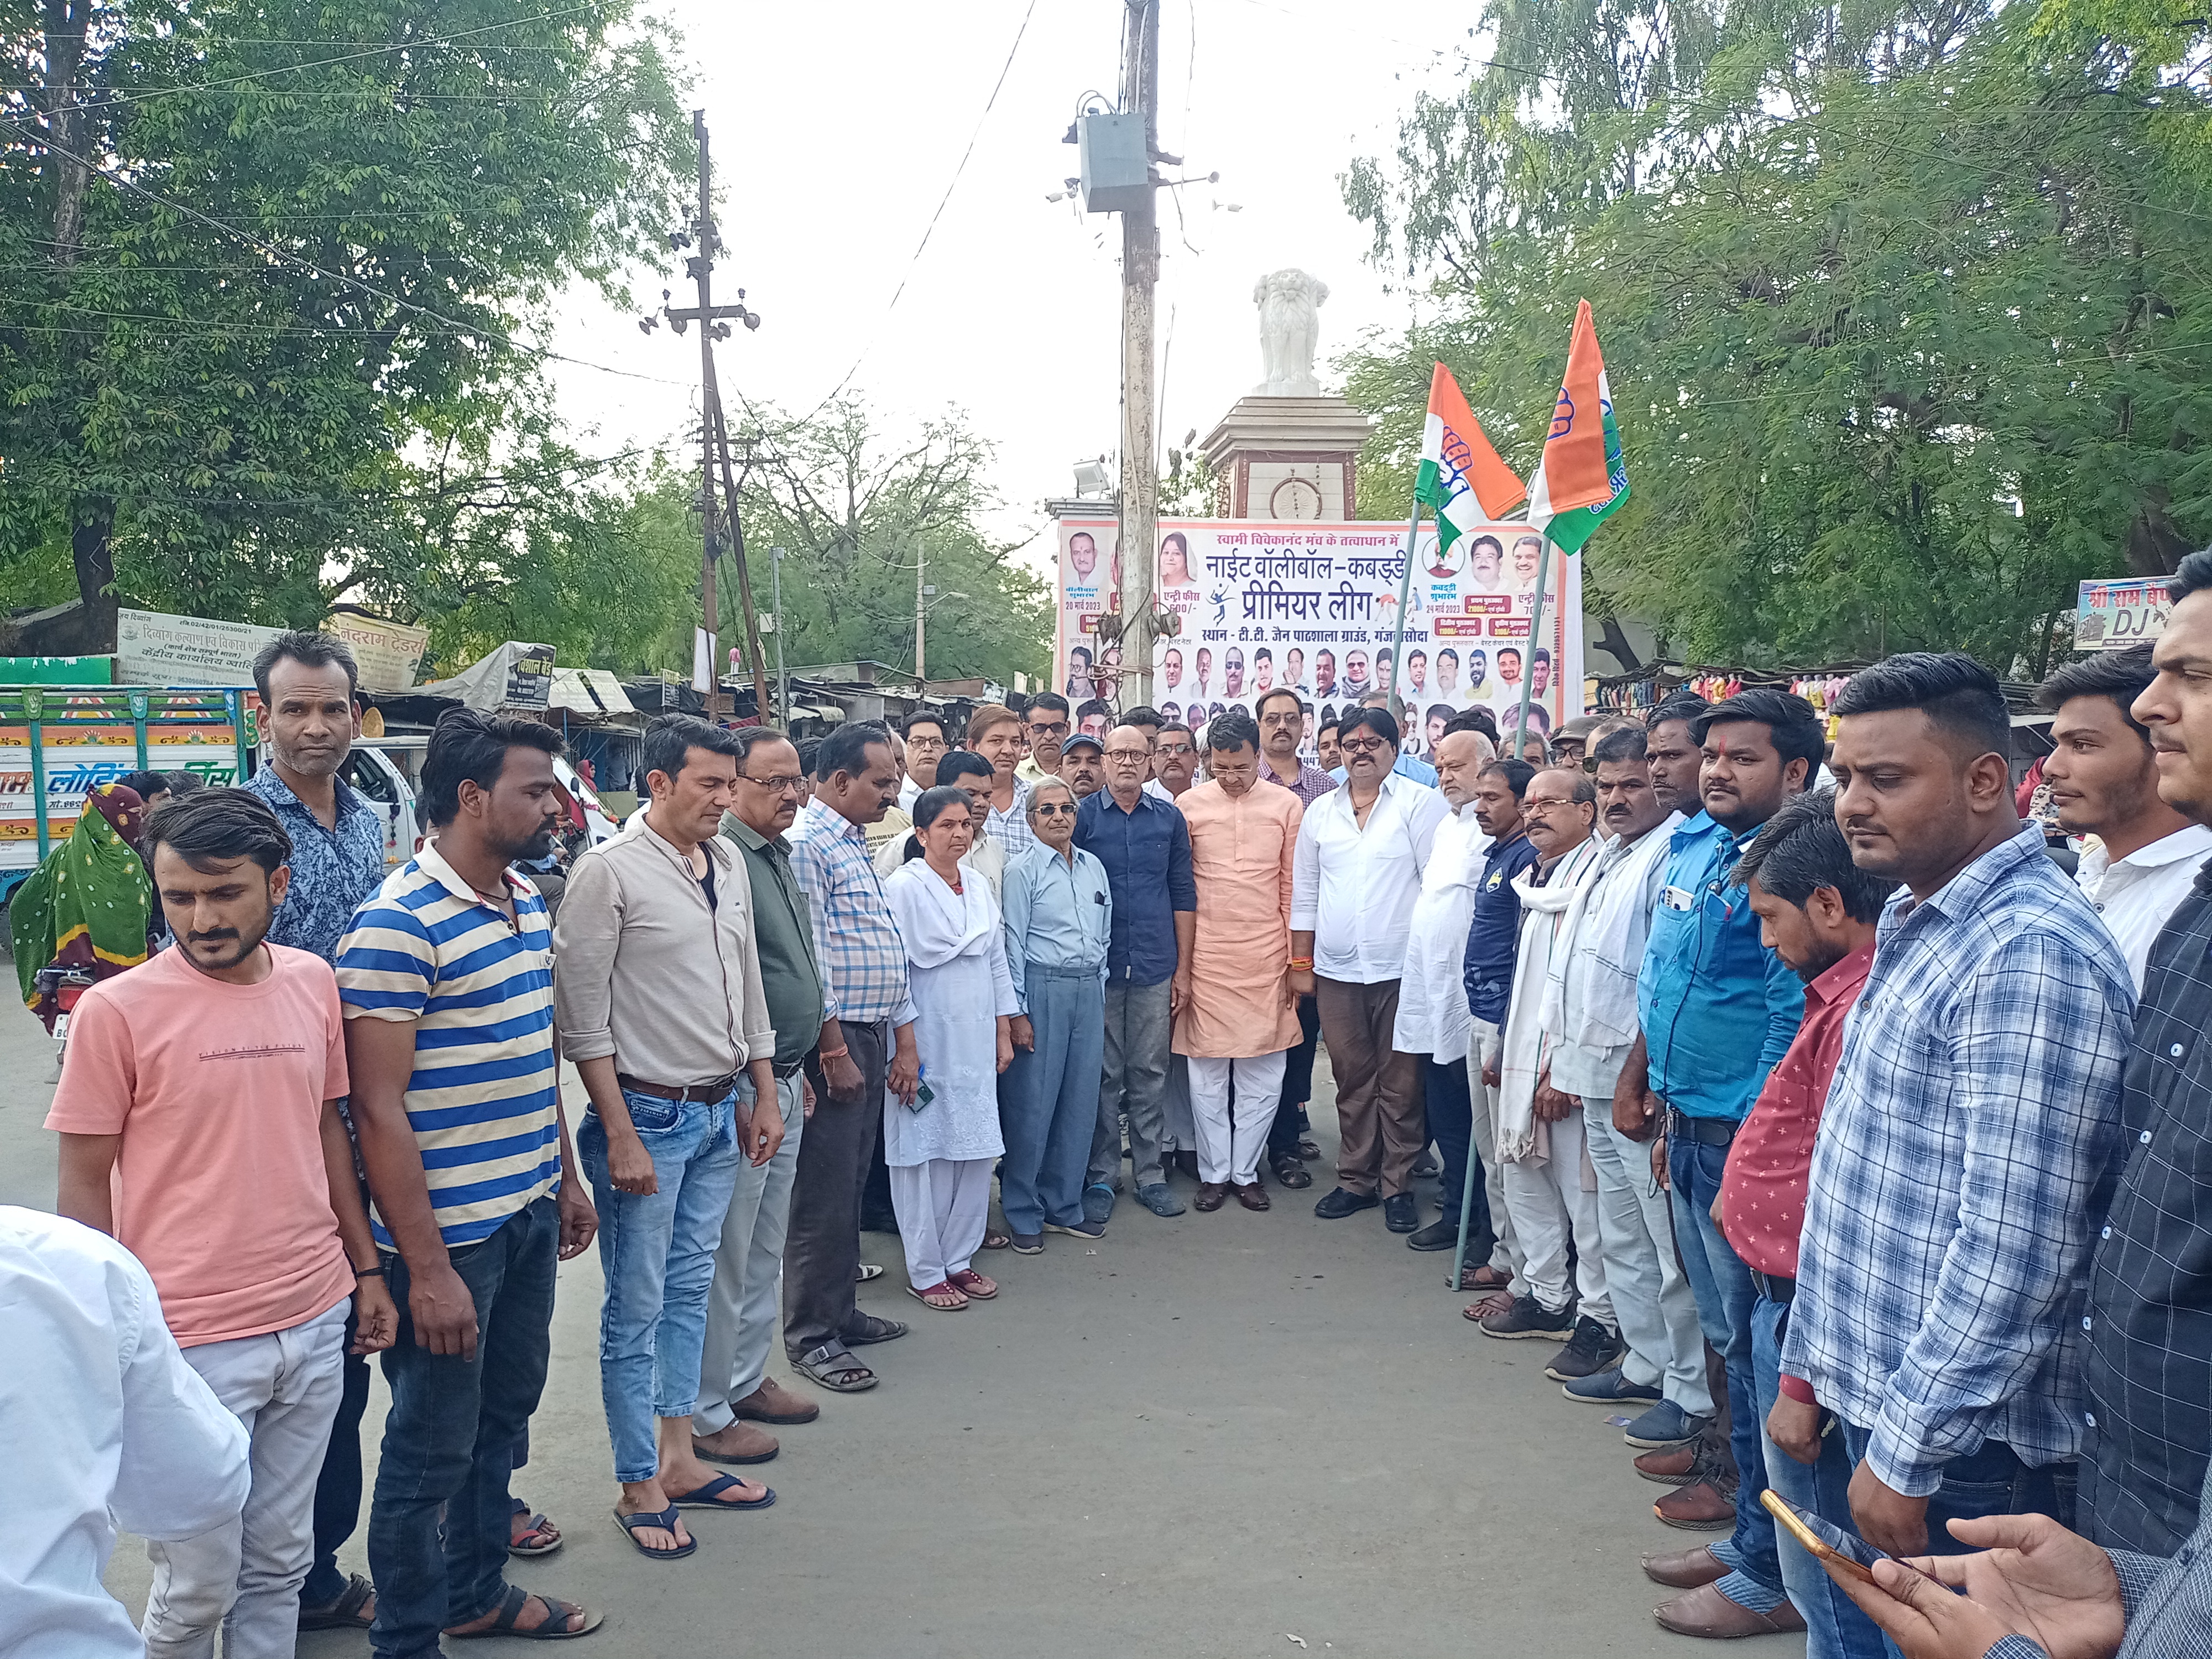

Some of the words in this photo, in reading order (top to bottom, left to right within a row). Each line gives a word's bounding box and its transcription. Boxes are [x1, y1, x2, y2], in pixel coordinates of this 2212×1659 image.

[1217, 533, 1247, 545] स्वामी
[1251, 533, 1302, 545] विवेकानंद
[1306, 533, 1323, 545] मंच
[1326, 533, 1337, 545] के
[1390, 534, 1400, 546] में
[1206, 547, 1251, 582] नाईट
[1066, 602, 1073, 611] 20
[1074, 599, 1084, 611] मार्च
[1086, 602, 1100, 611] 2023
[1183, 590, 1200, 601] फीस
[1242, 580, 1322, 620] प्रीमियर
[1328, 581, 1373, 620] लीग
[2088, 586, 2109, 608] श्री
[2113, 589, 2141, 608] राम
[1434, 603, 1444, 613] मार्च
[1445, 605, 1460, 613] 2023
[2112, 608, 2149, 636] DJ
[143, 624, 172, 641] दिव्यांग
[175, 632, 203, 645] कल्याण
[206, 632, 216, 646] एवं
[219, 633, 246, 651] विकास
[341, 623, 387, 648] नंदराम
[390, 629, 427, 654] ट्रेडर्स
[1202, 629, 1227, 642] स्थान
[1272, 626, 1290, 642] जैन
[1293, 630, 1339, 642] पाठशाला
[142, 647, 173, 659] केंद्रीय
[176, 653, 223, 666] कार्यालय
